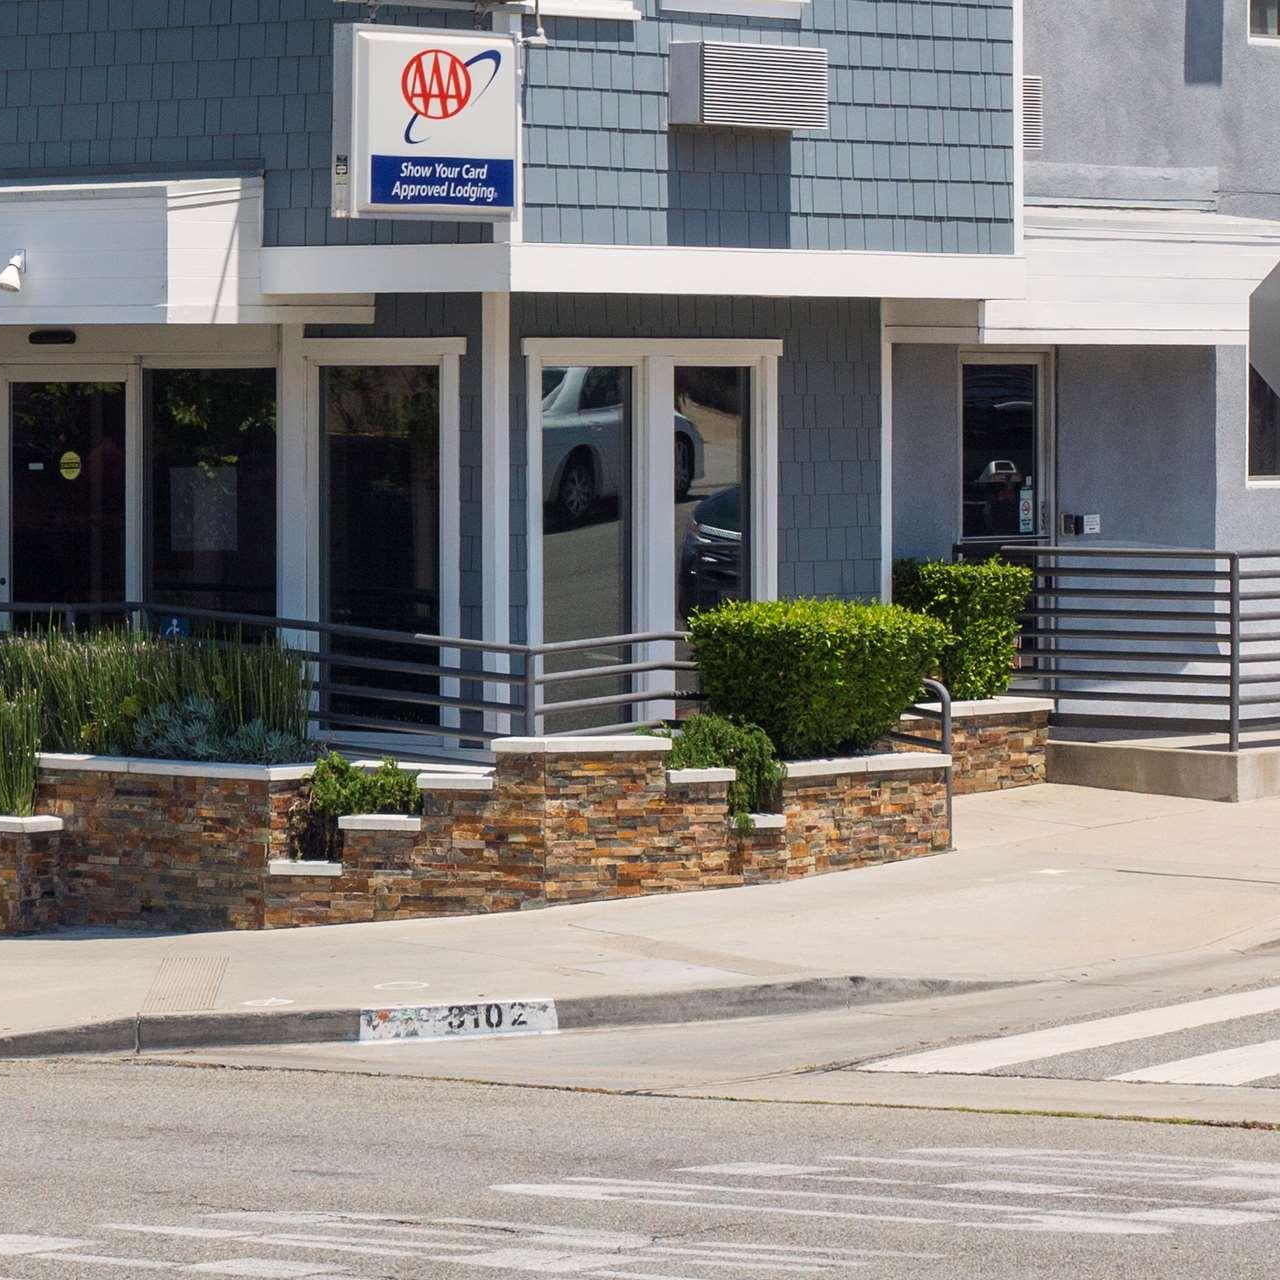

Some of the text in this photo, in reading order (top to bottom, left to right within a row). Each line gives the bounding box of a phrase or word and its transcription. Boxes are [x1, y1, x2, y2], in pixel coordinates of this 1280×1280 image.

[406, 50, 468, 118] AAA
[400, 162, 487, 179] Show Your Card
[392, 181, 447, 200] Approved
